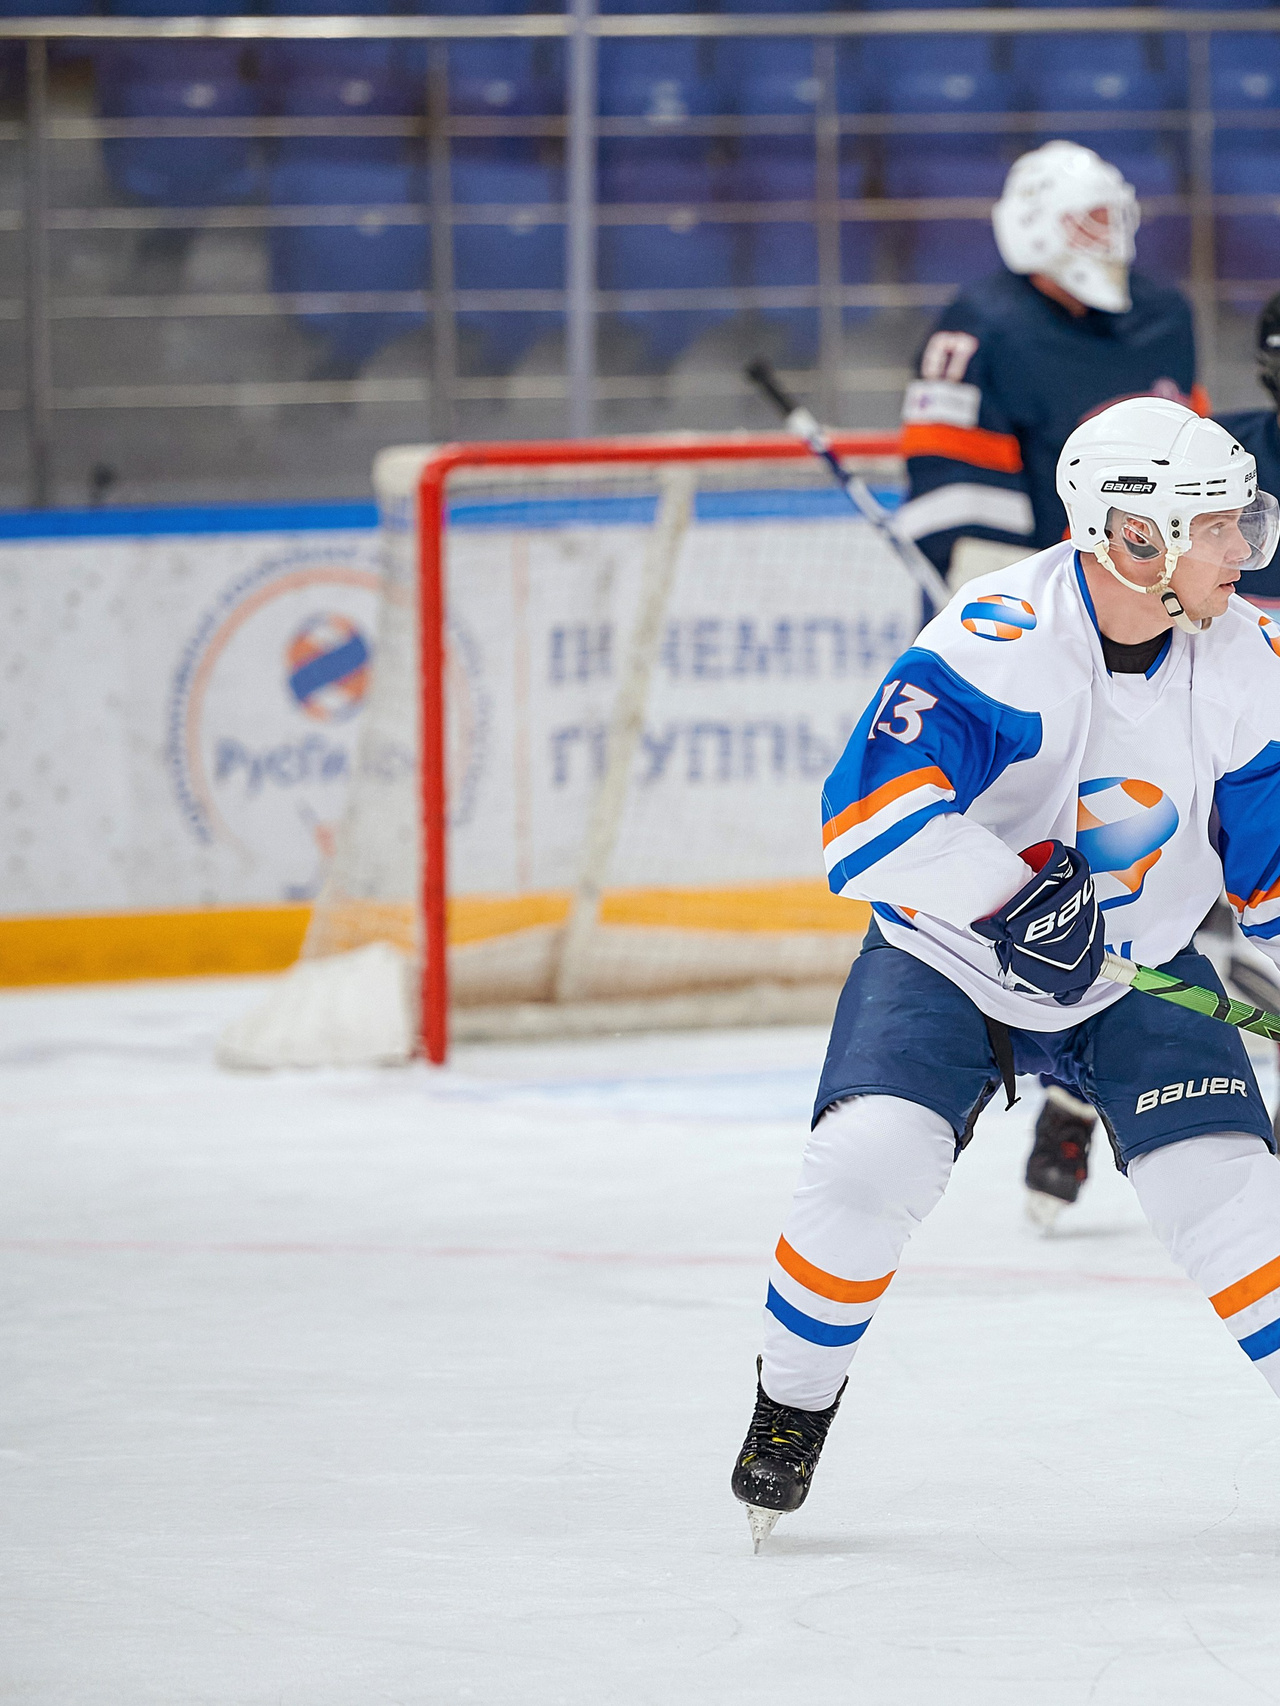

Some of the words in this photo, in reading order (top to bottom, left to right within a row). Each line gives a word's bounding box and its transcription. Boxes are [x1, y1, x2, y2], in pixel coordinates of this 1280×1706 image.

[1102, 482, 1154, 492] BAUER
[867, 679, 938, 744] 13
[1135, 1077, 1248, 1115] BAUER
